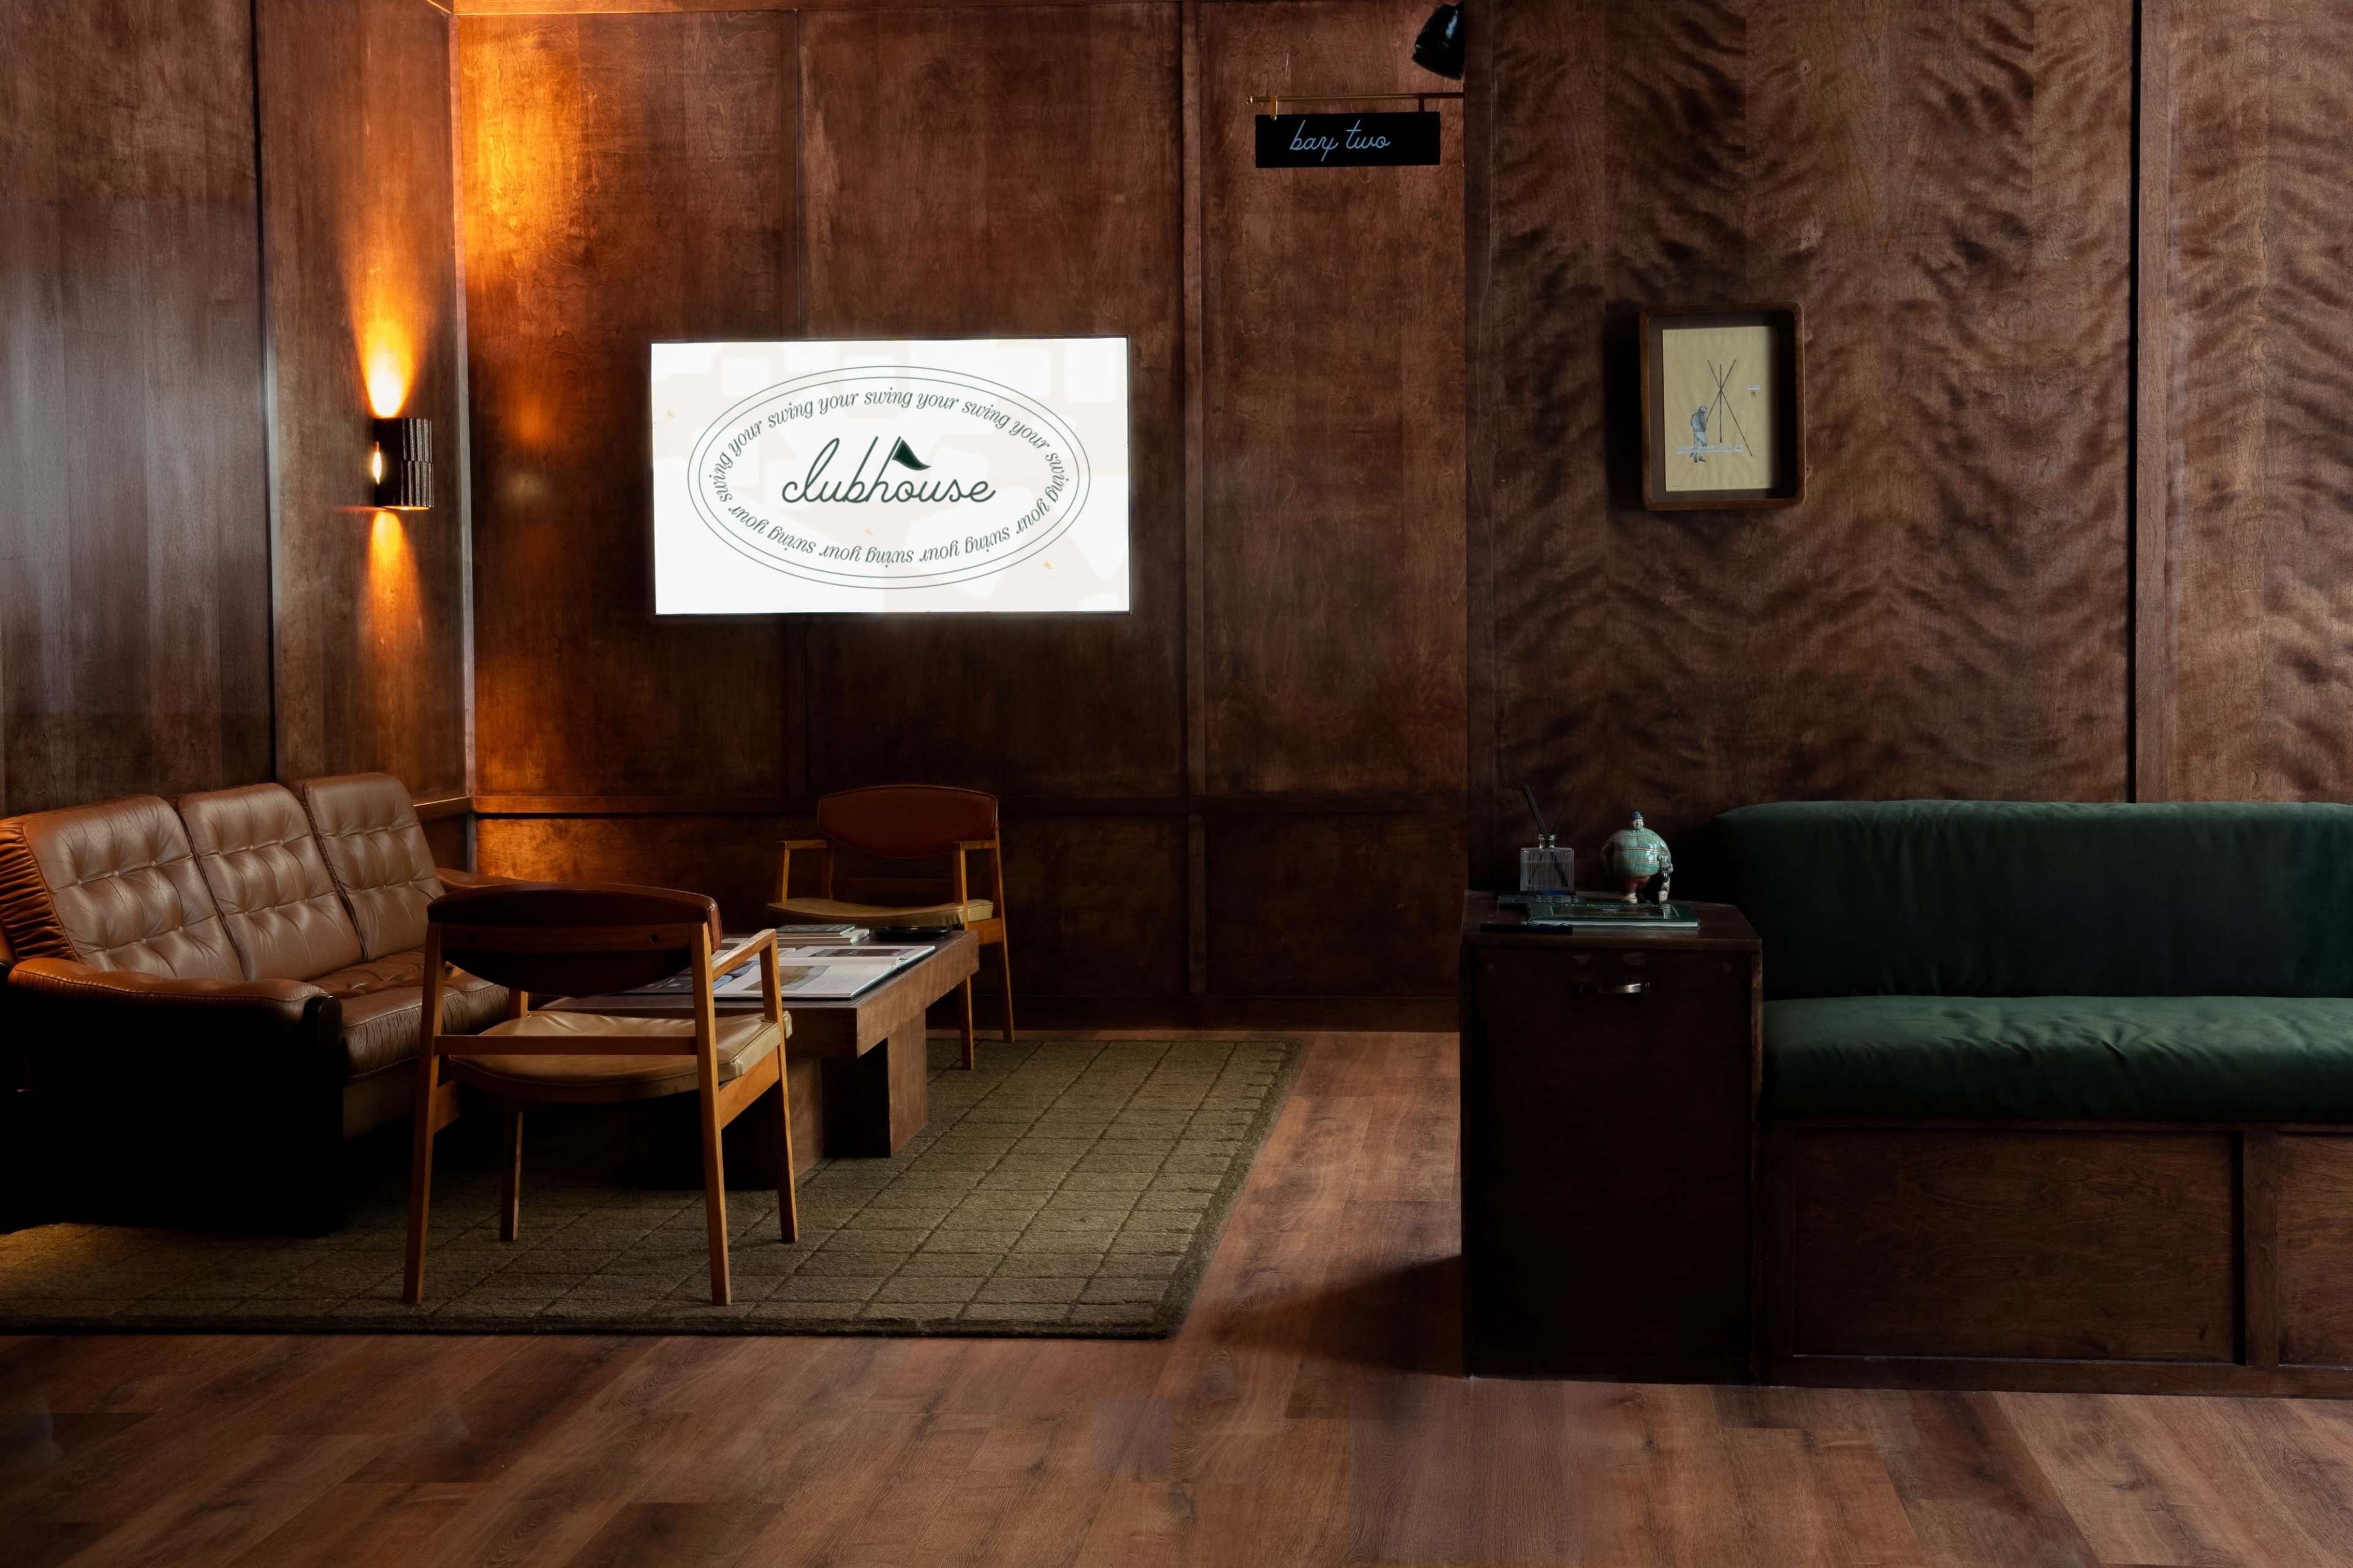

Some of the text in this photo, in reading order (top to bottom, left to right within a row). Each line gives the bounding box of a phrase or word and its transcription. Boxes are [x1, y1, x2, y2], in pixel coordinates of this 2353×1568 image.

[1290, 120, 1390, 161] bay two
[709, 388, 1069, 567] swing your swing your swing your swing your swing your swing your swing your swing your
[782, 436, 996, 503] clubhouse
